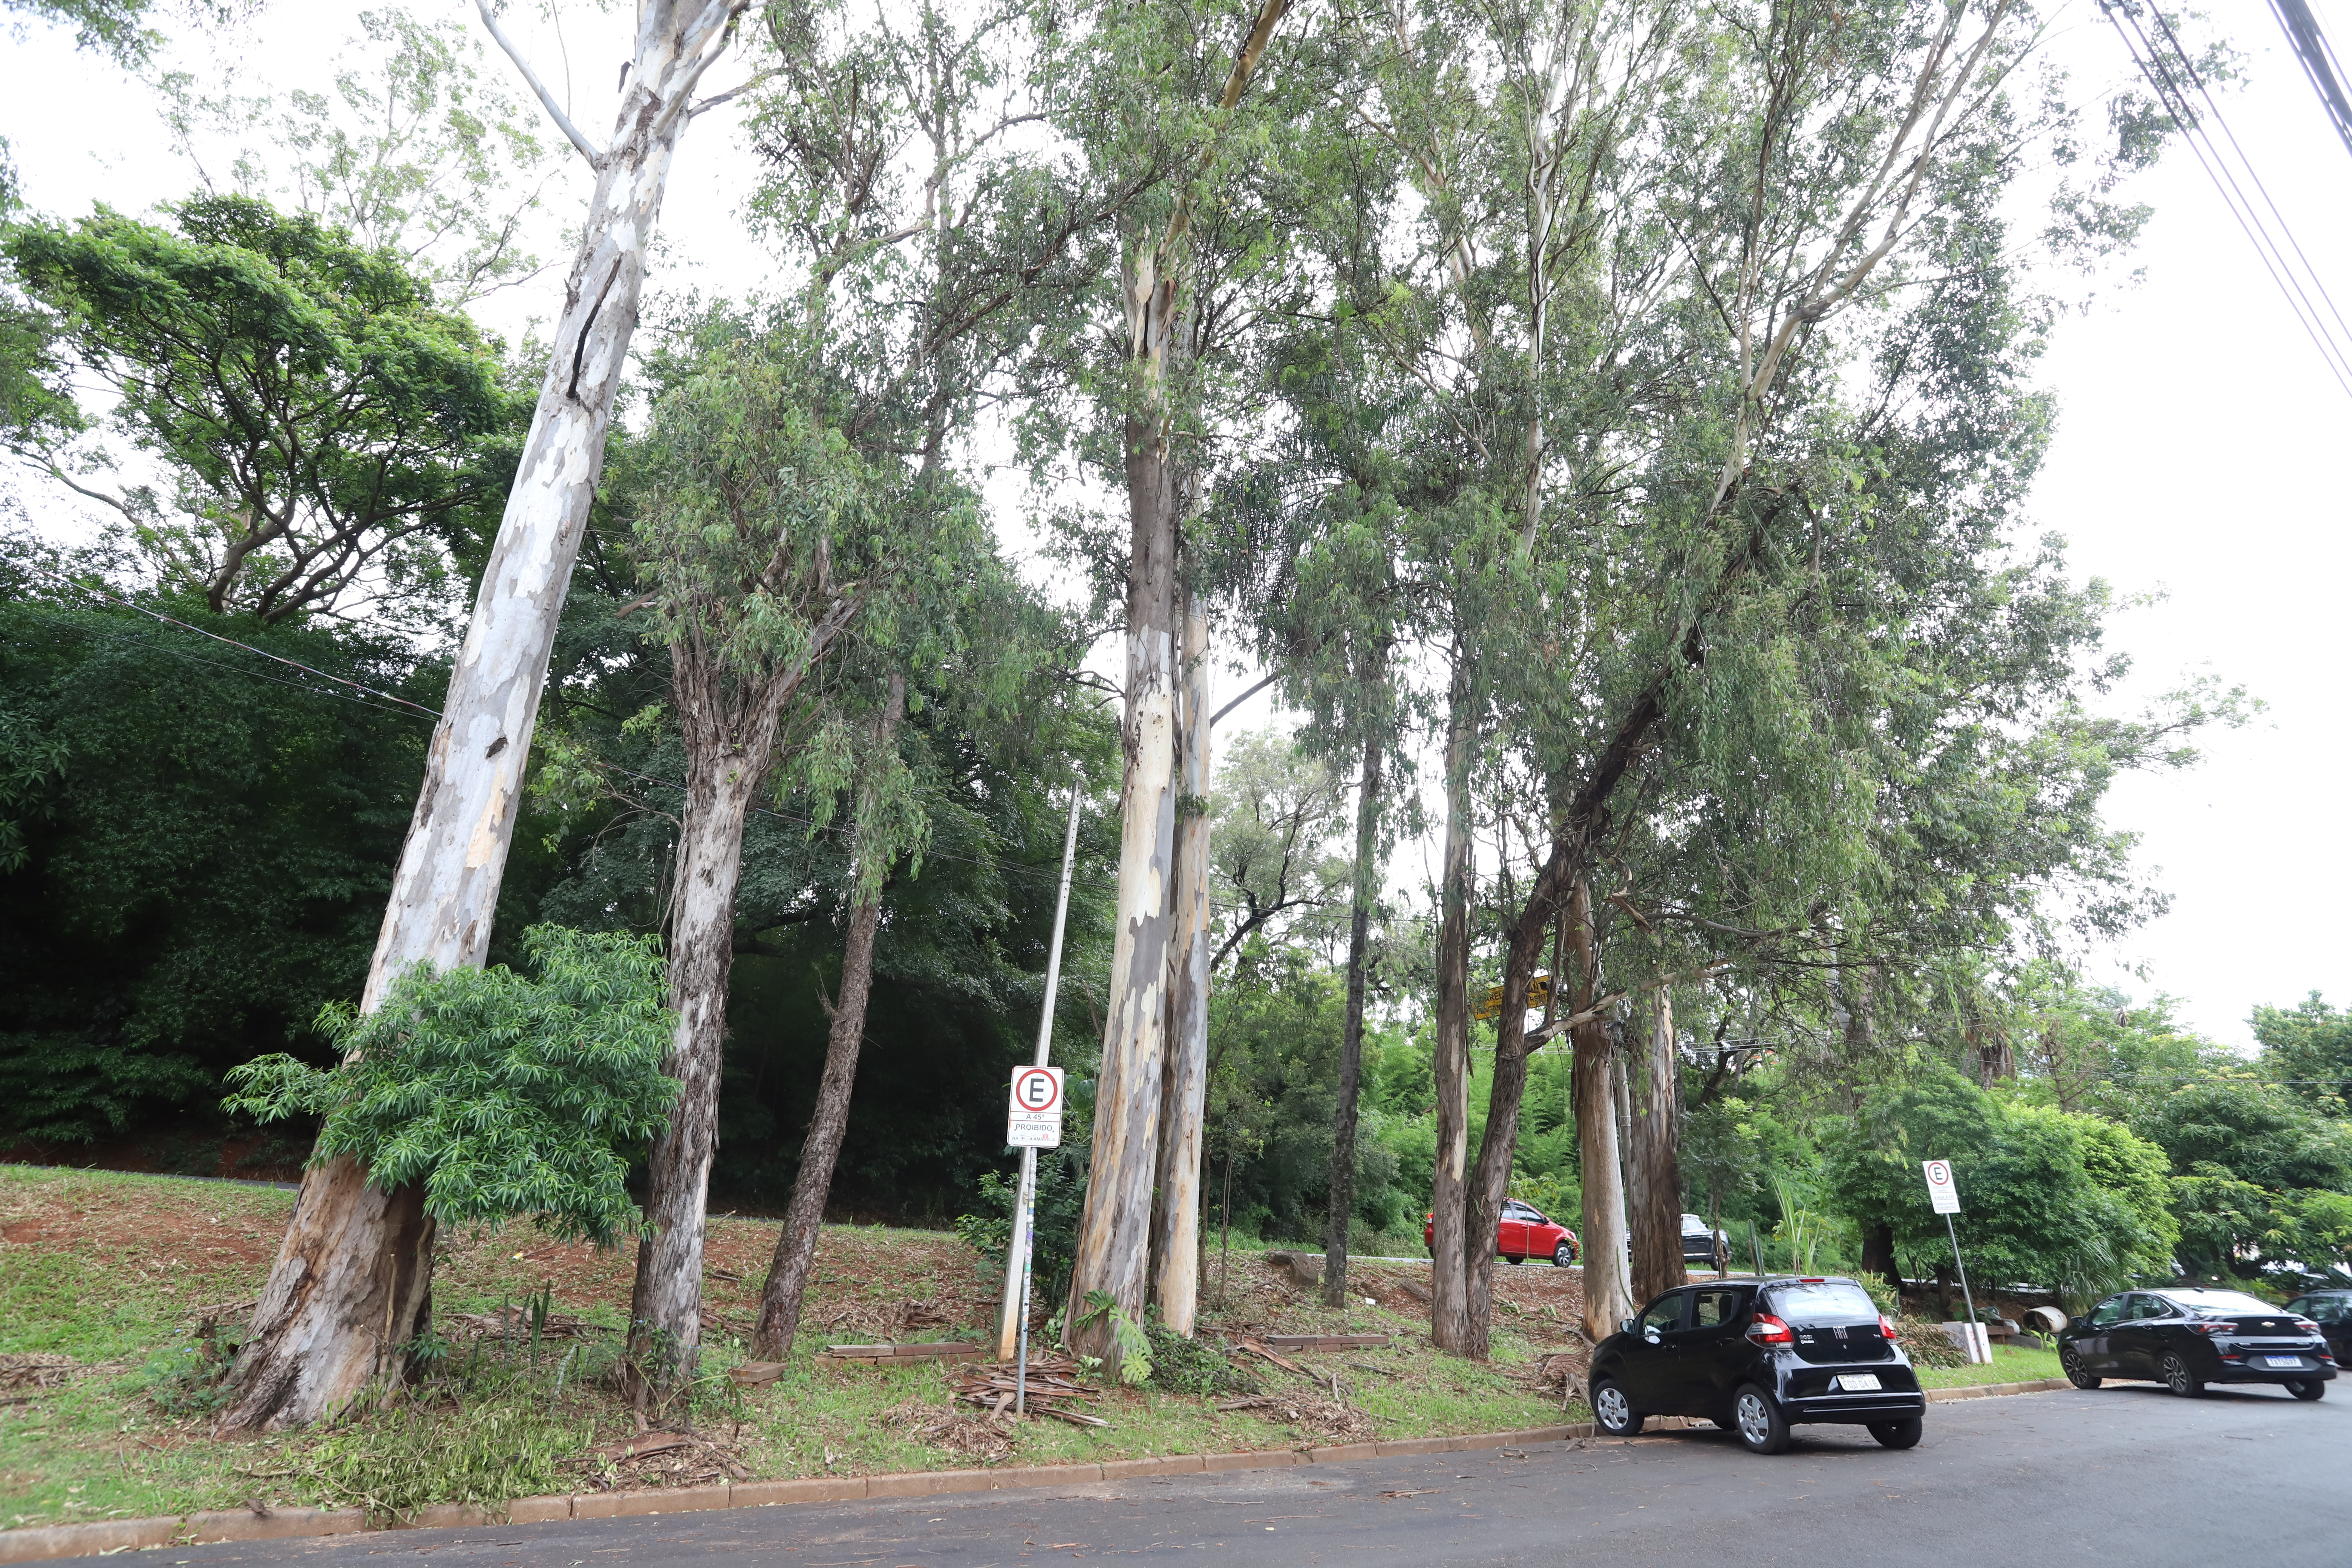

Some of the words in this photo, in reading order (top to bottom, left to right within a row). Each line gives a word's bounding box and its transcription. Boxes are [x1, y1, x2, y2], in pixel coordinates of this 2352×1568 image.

[1029, 1078, 1044, 1102] E
[1934, 1167, 1943, 1180] E
[1833, 1326, 1848, 1339] FIAT
